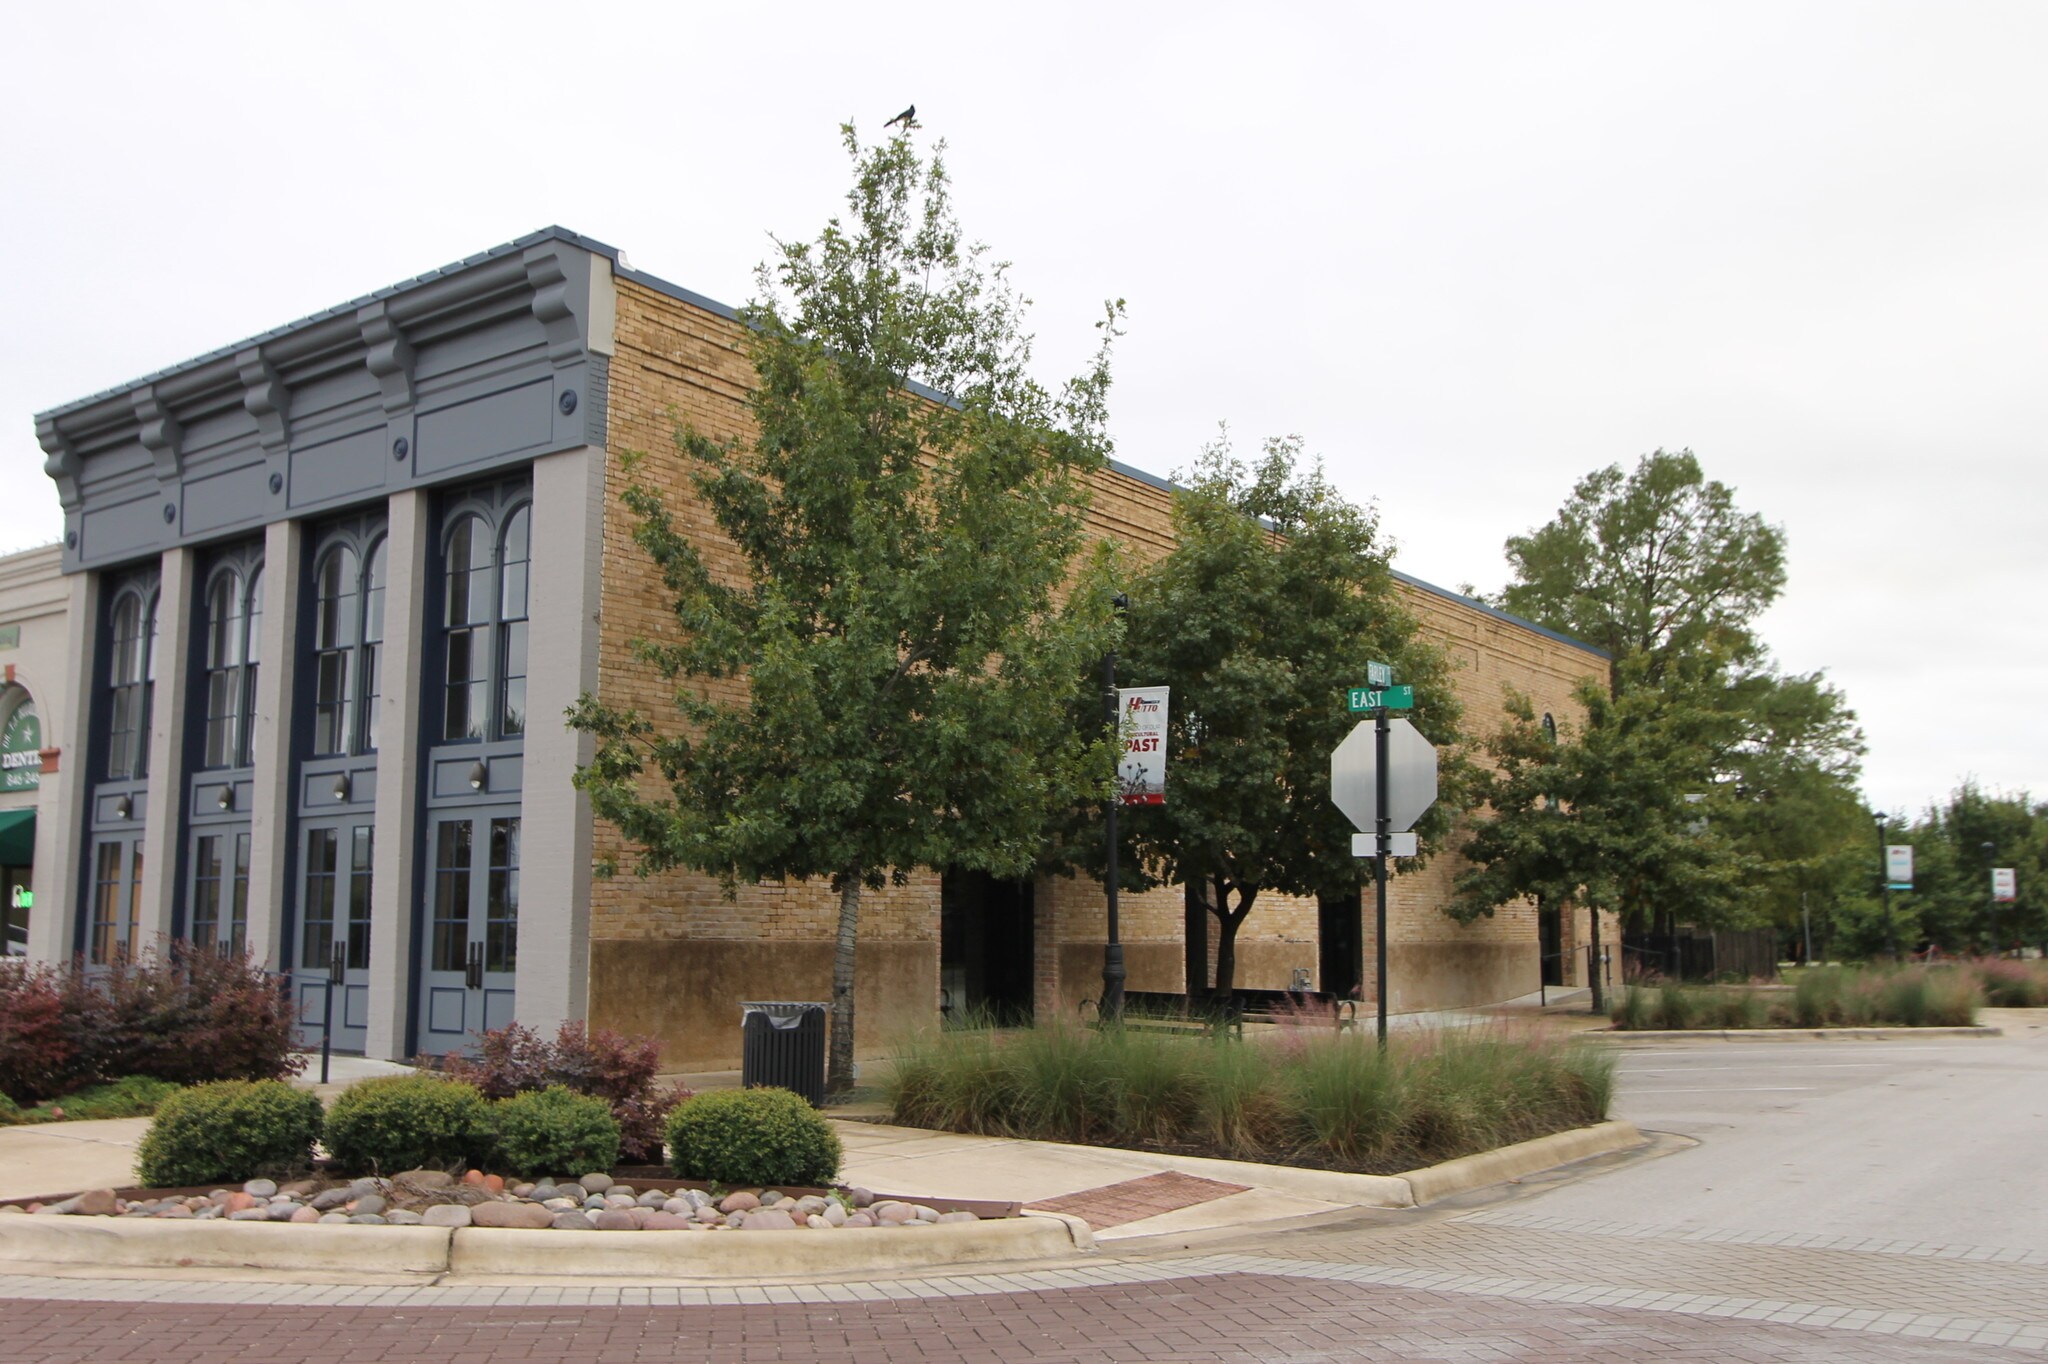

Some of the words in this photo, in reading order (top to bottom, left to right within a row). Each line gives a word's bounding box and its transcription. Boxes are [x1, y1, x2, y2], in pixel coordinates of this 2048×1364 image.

[1352, 691, 1382, 708] EAST
[1403, 686, 1411, 695] ST
[1125, 738, 1159, 752] PAST
